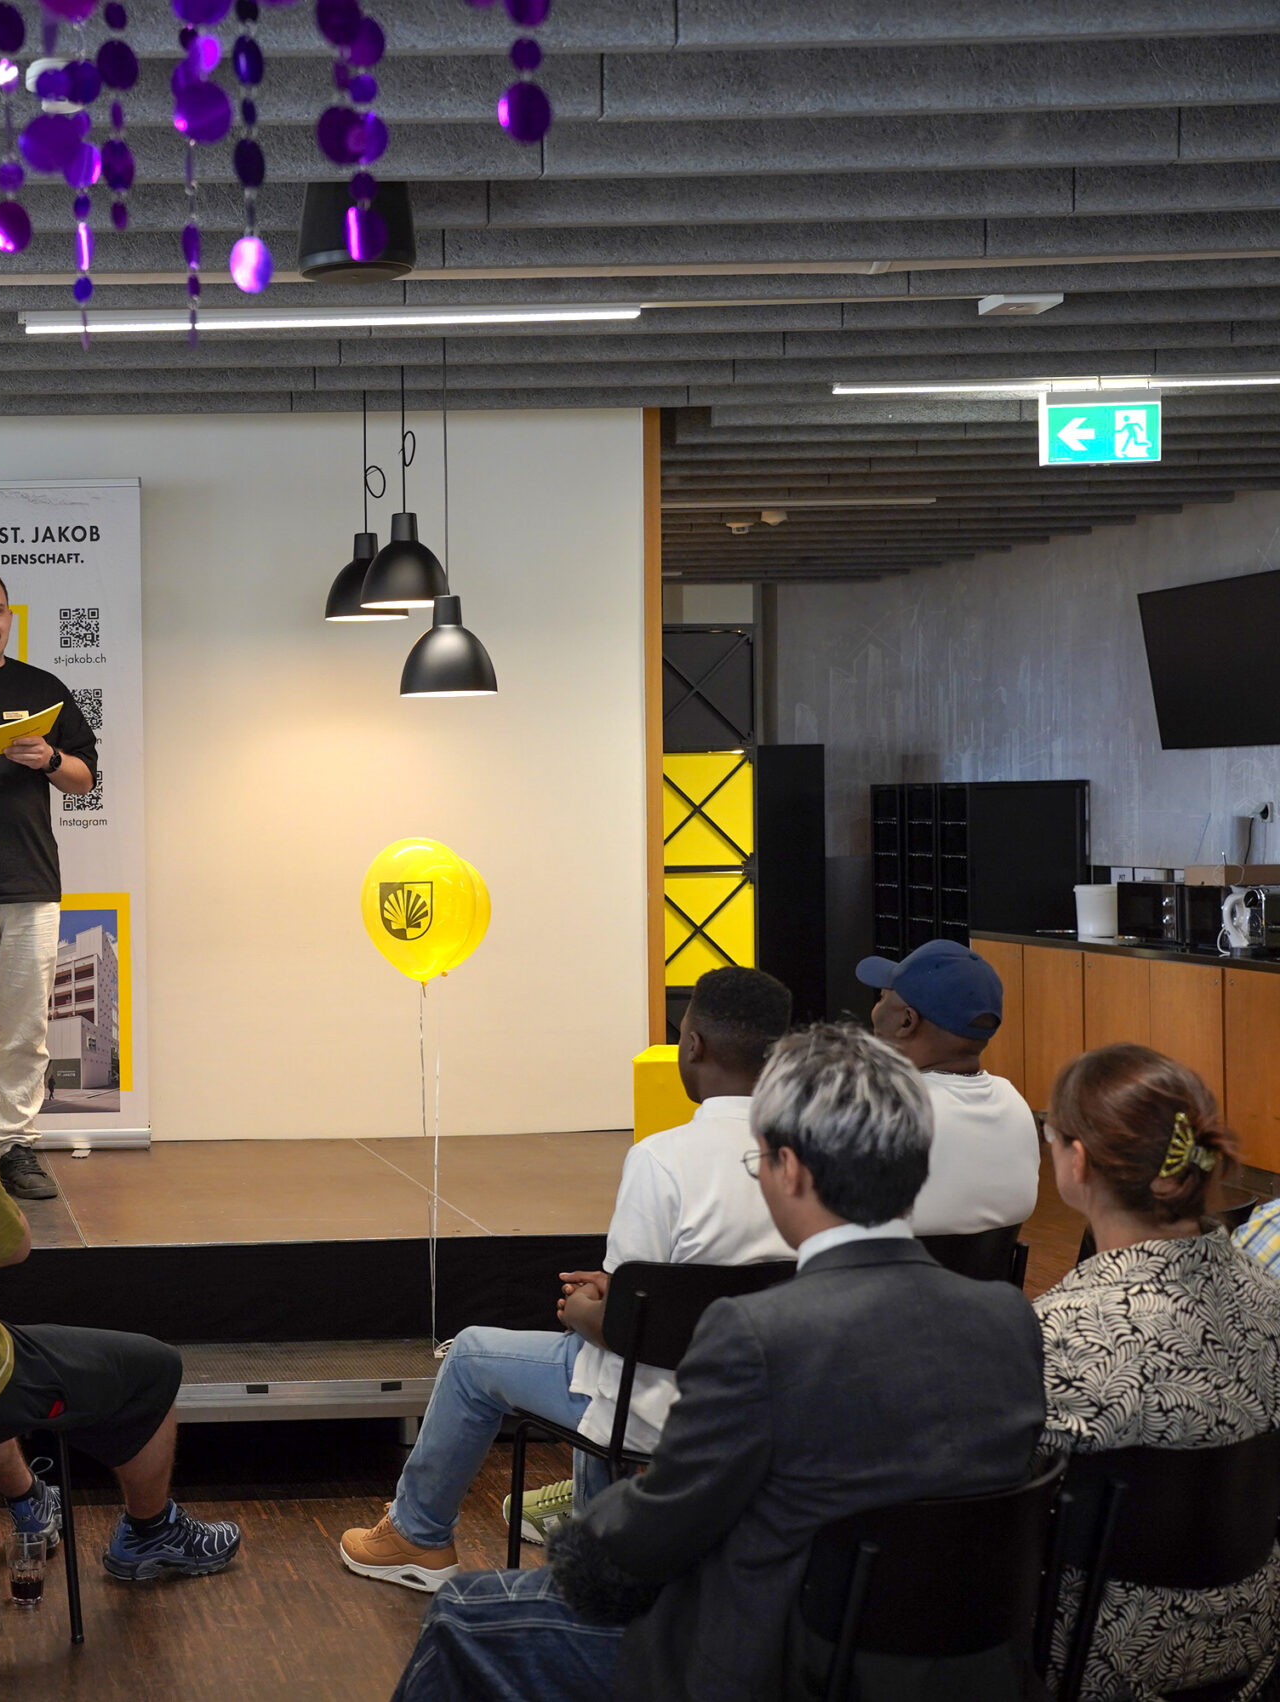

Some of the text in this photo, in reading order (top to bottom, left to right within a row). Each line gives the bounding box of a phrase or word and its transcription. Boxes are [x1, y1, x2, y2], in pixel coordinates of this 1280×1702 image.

[31, 525, 101, 544] JAKOB
[53, 652, 107, 667] st-jakob.ch
[59, 816, 108, 829] Instagram
